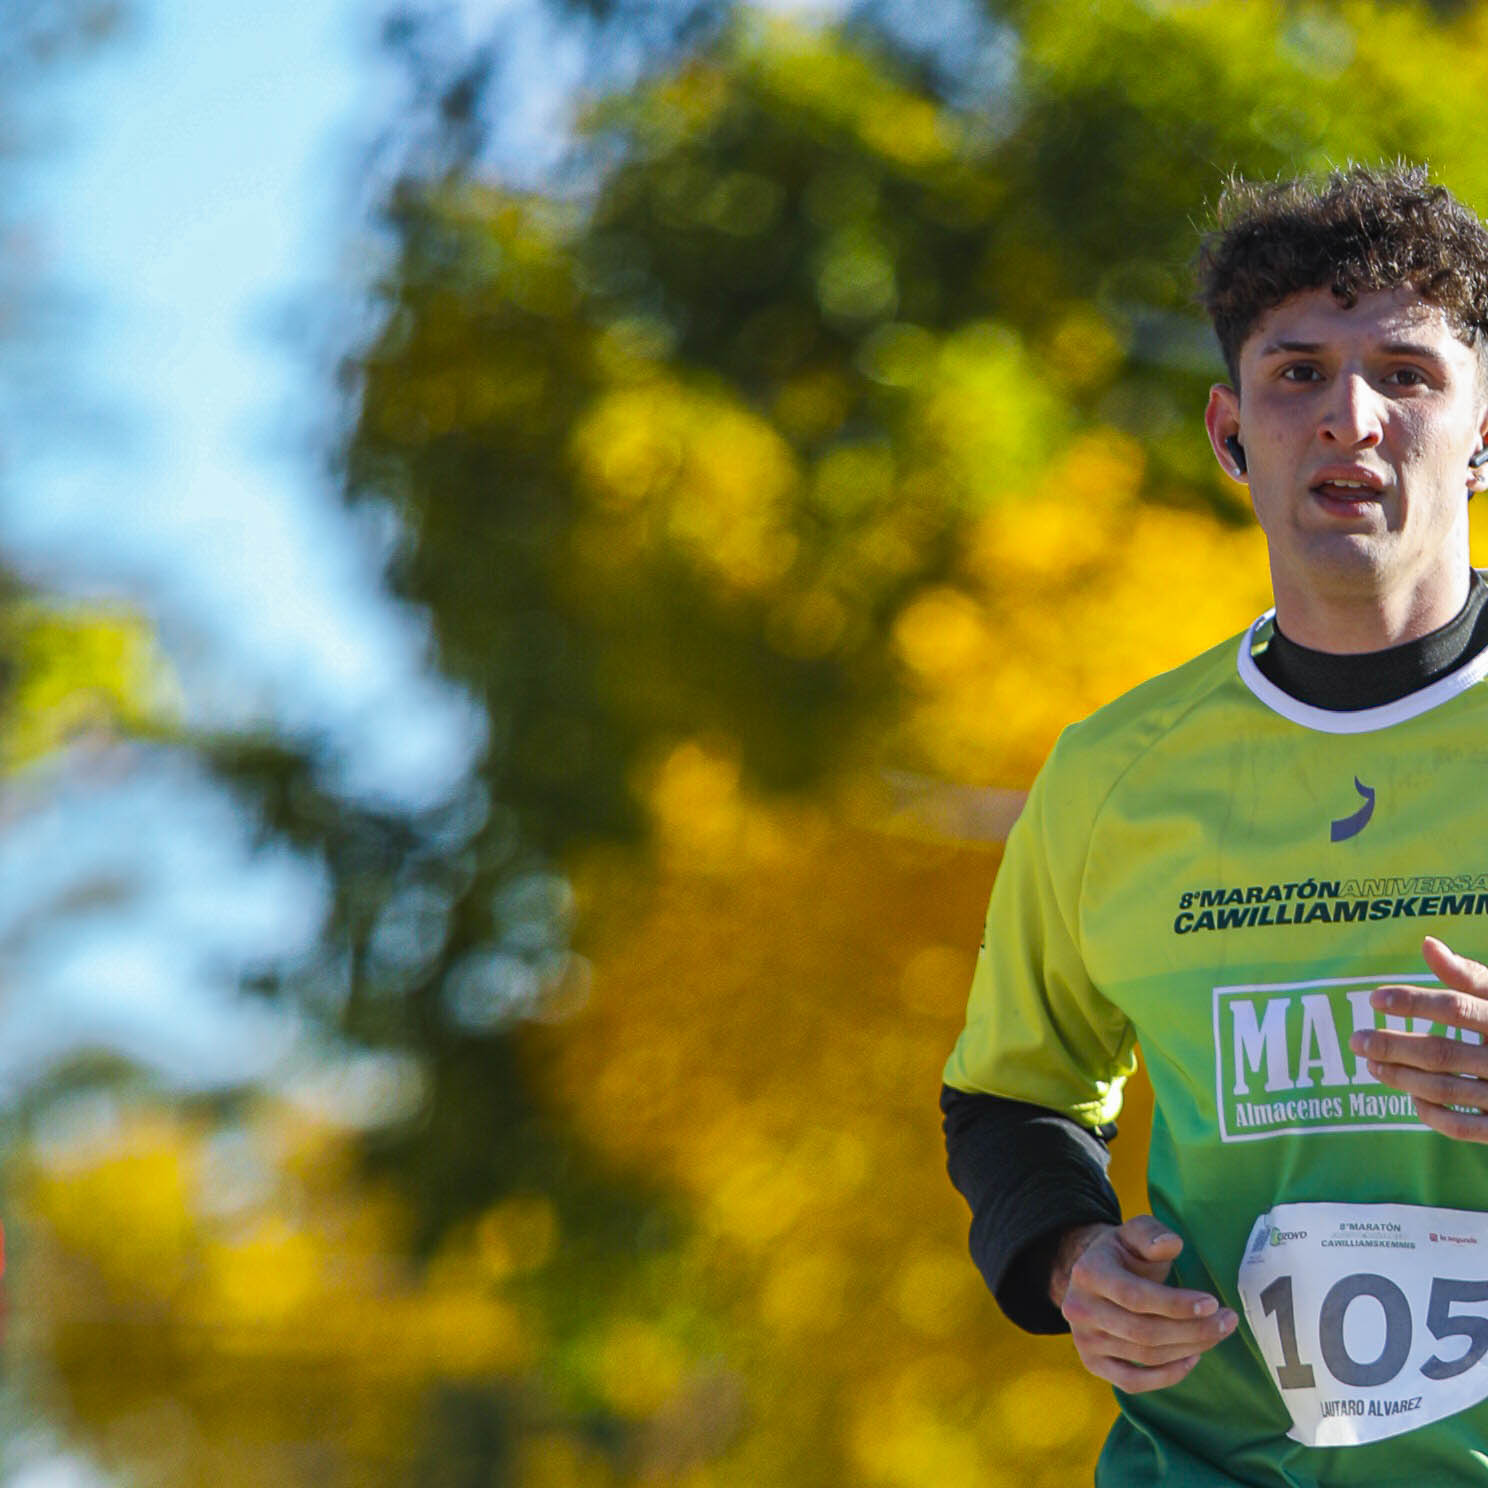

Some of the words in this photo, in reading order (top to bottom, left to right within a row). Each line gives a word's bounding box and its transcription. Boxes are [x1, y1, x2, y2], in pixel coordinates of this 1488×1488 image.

[1235, 1097, 1343, 1127] Almacenes
[1320, 1400, 1365, 1418] LAUTARO
[1367, 1396, 1423, 1417] ALVAREZ
